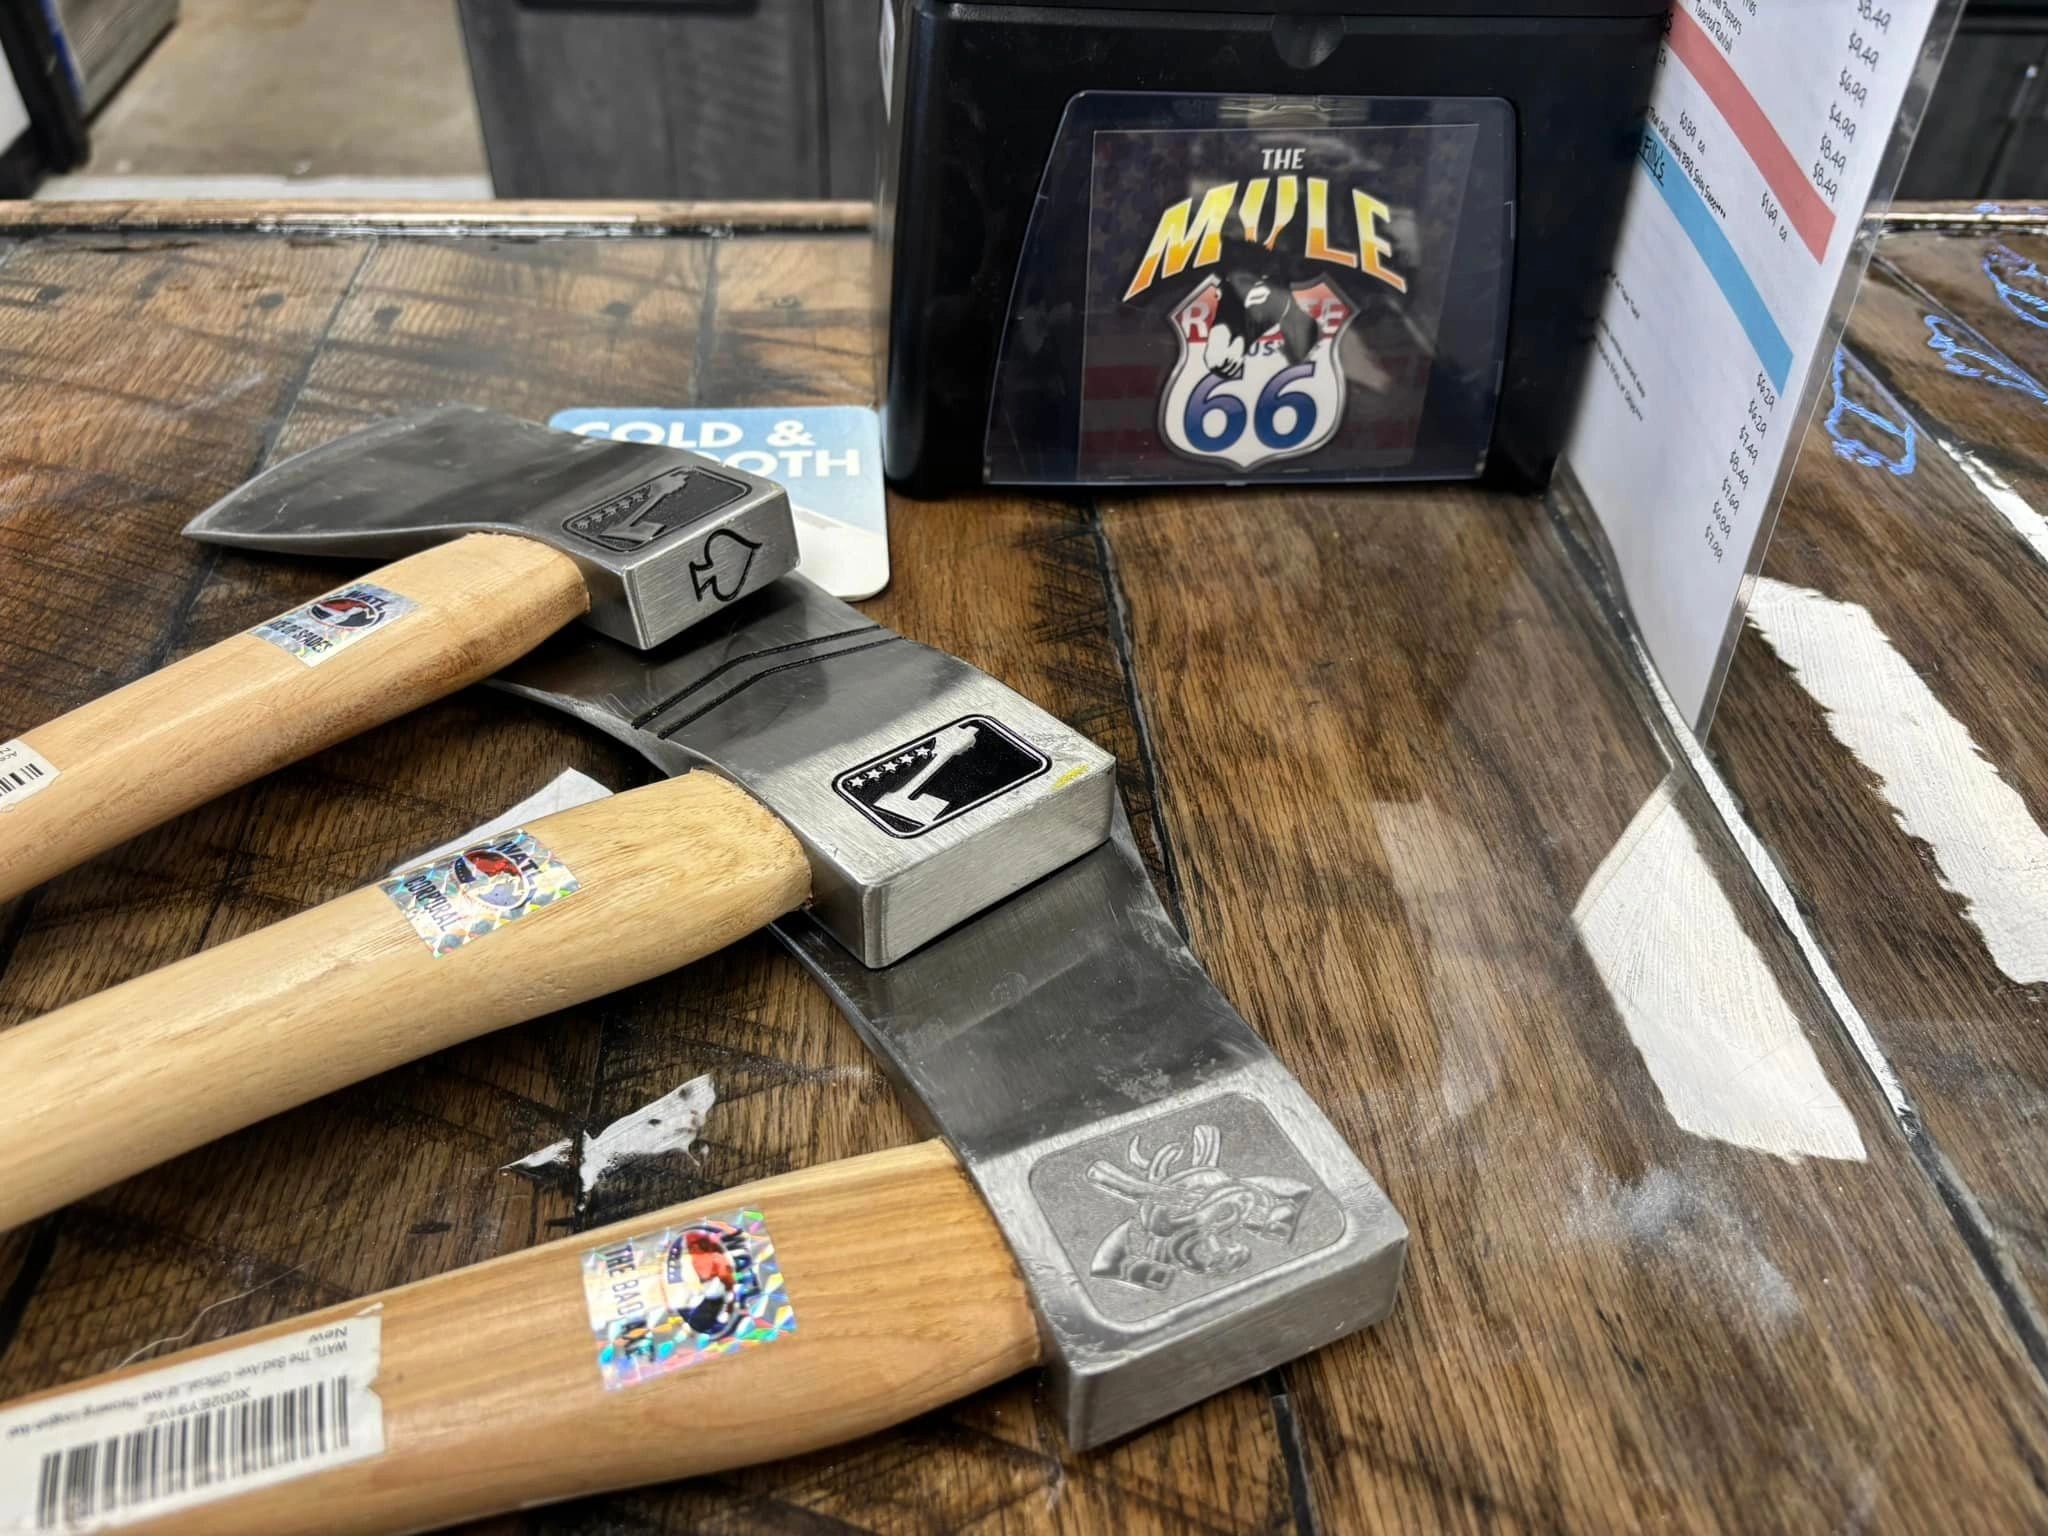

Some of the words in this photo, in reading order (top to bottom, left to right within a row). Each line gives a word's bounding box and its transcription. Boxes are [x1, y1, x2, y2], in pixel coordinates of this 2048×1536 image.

[1848, 28, 1879, 72] $9.49
[1839, 65, 1867, 108] $6.99
[1828, 100, 1856, 143] $4.99
[1262, 147, 1307, 171] THE
[1820, 132, 1846, 176] $8.49
[1812, 160, 1838, 203] $8.49
[1122, 174, 1408, 303] MULE
[1183, 361, 1318, 453] 66
[766, 420, 816, 448] &
[1739, 424, 1758, 466] $7.49
[1730, 449, 1749, 491] $8.49
[1722, 476, 1740, 516] $7.69
[1705, 524, 1723, 564] $7.99
[404, 874, 458, 932] CORPORAL
[605, 1245, 635, 1278] THE
[612, 1279, 644, 1316] BAD
[309, 1325, 348, 1344] New
